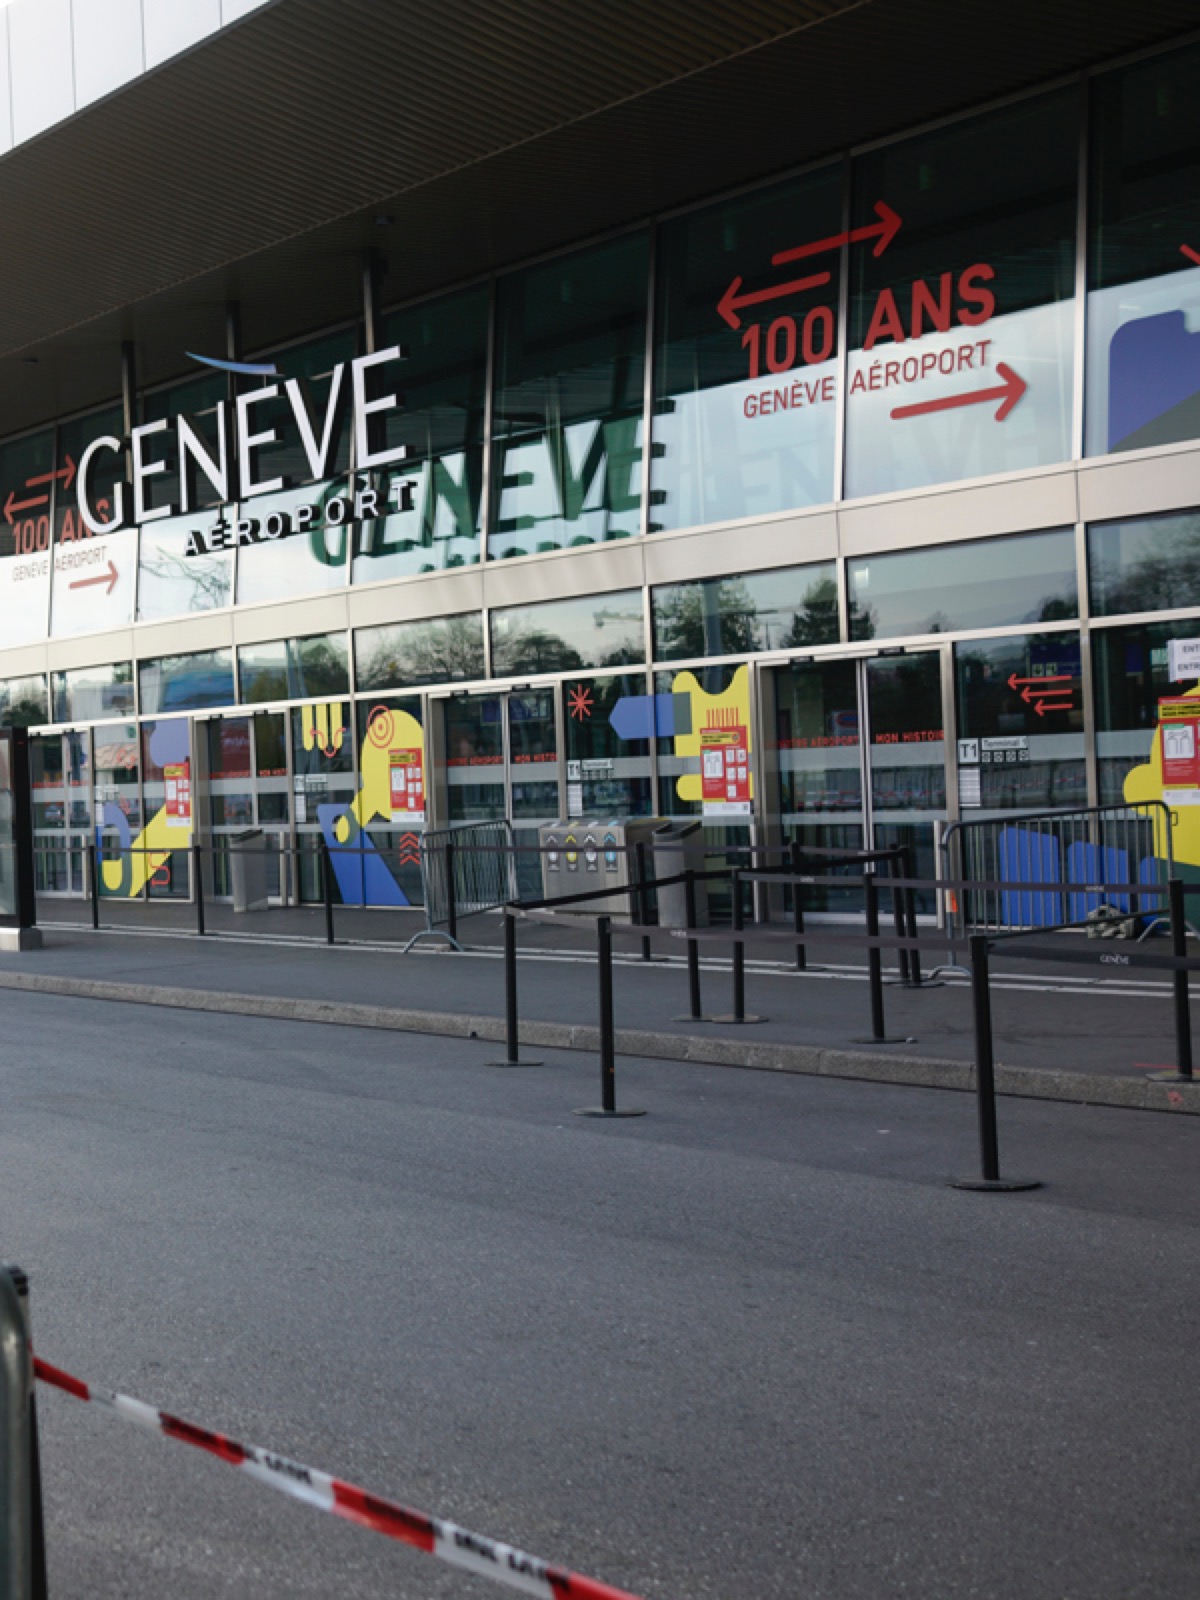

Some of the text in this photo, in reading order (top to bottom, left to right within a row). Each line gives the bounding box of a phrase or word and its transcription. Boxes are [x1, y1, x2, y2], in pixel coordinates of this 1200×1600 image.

[742, 262, 996, 379] 100 ANS
[743, 340, 992, 419] GENÈVE AÉROPORT
[12, 515, 49, 556] 100
[185, 481, 417, 556] AÉROPORT
[960, 743, 977, 758] T1
